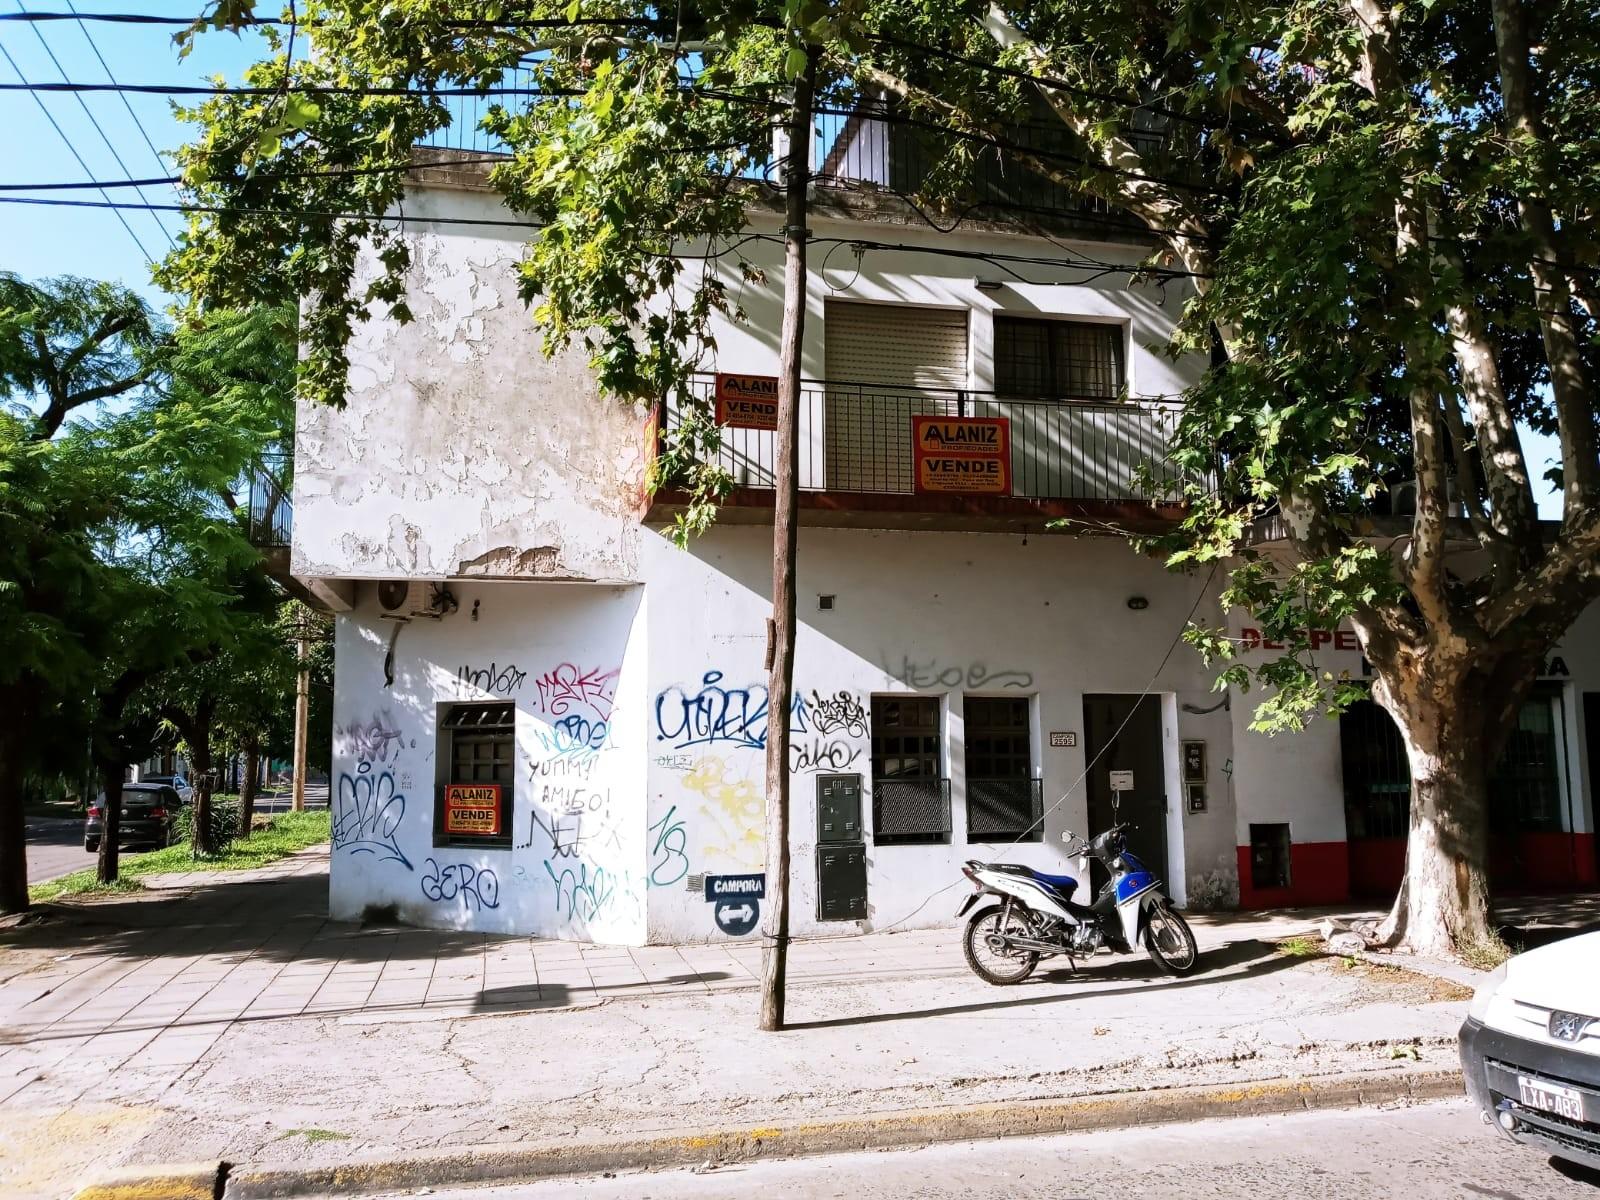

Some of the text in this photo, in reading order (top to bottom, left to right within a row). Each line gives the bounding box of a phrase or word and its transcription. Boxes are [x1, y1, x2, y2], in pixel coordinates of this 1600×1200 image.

[724, 378, 778, 393] ALANI
[727, 401, 777, 415] VEND
[924, 425, 998, 445] ALANIZ
[925, 459, 1000, 473] VENDE
[450, 788, 494, 802] ALANIZ
[452, 810, 493, 820] VENDE
[713, 878, 762, 894] CAMPORA
